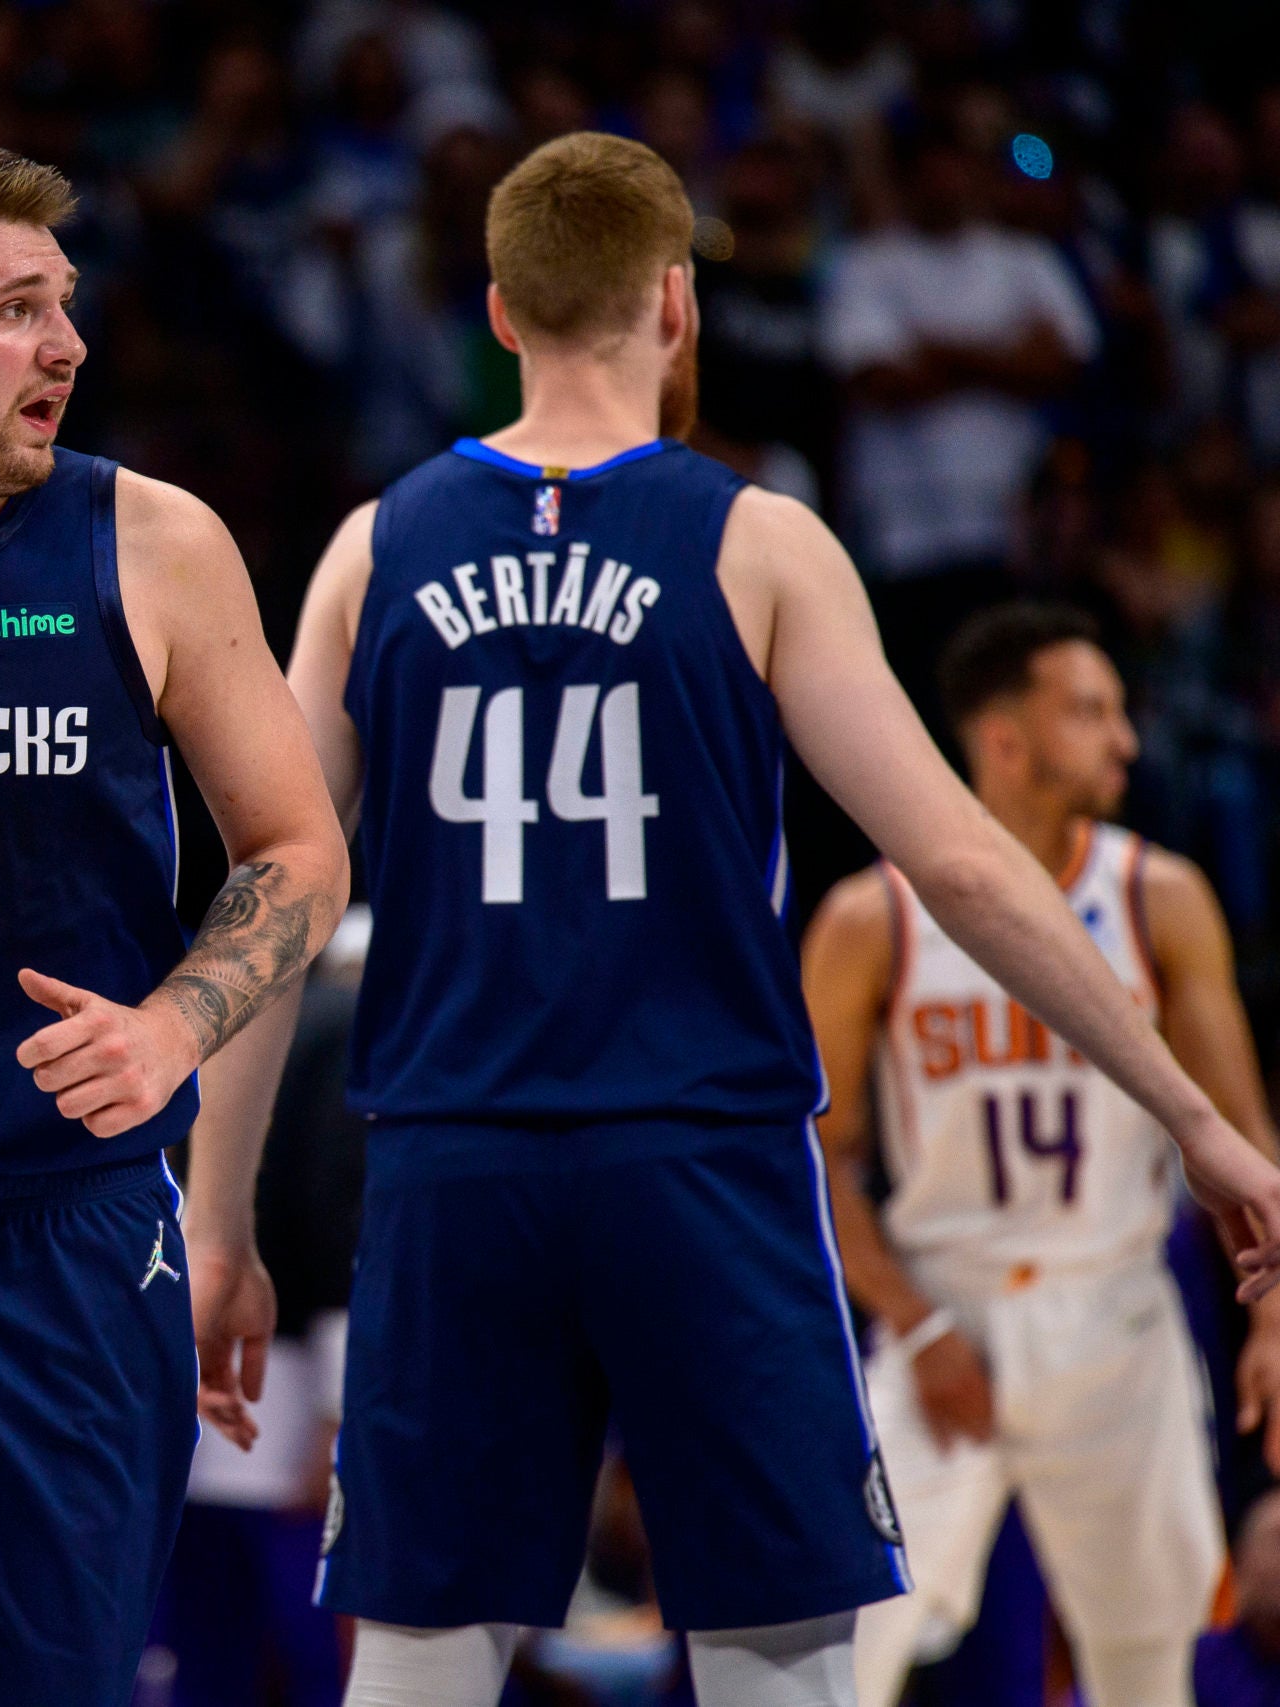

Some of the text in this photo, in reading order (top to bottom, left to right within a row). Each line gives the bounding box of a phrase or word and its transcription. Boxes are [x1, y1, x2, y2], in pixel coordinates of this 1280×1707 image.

[414, 543, 661, 649] BERTĀNS
[428, 682, 659, 904] 44
[981, 1086, 1082, 1208] 14
